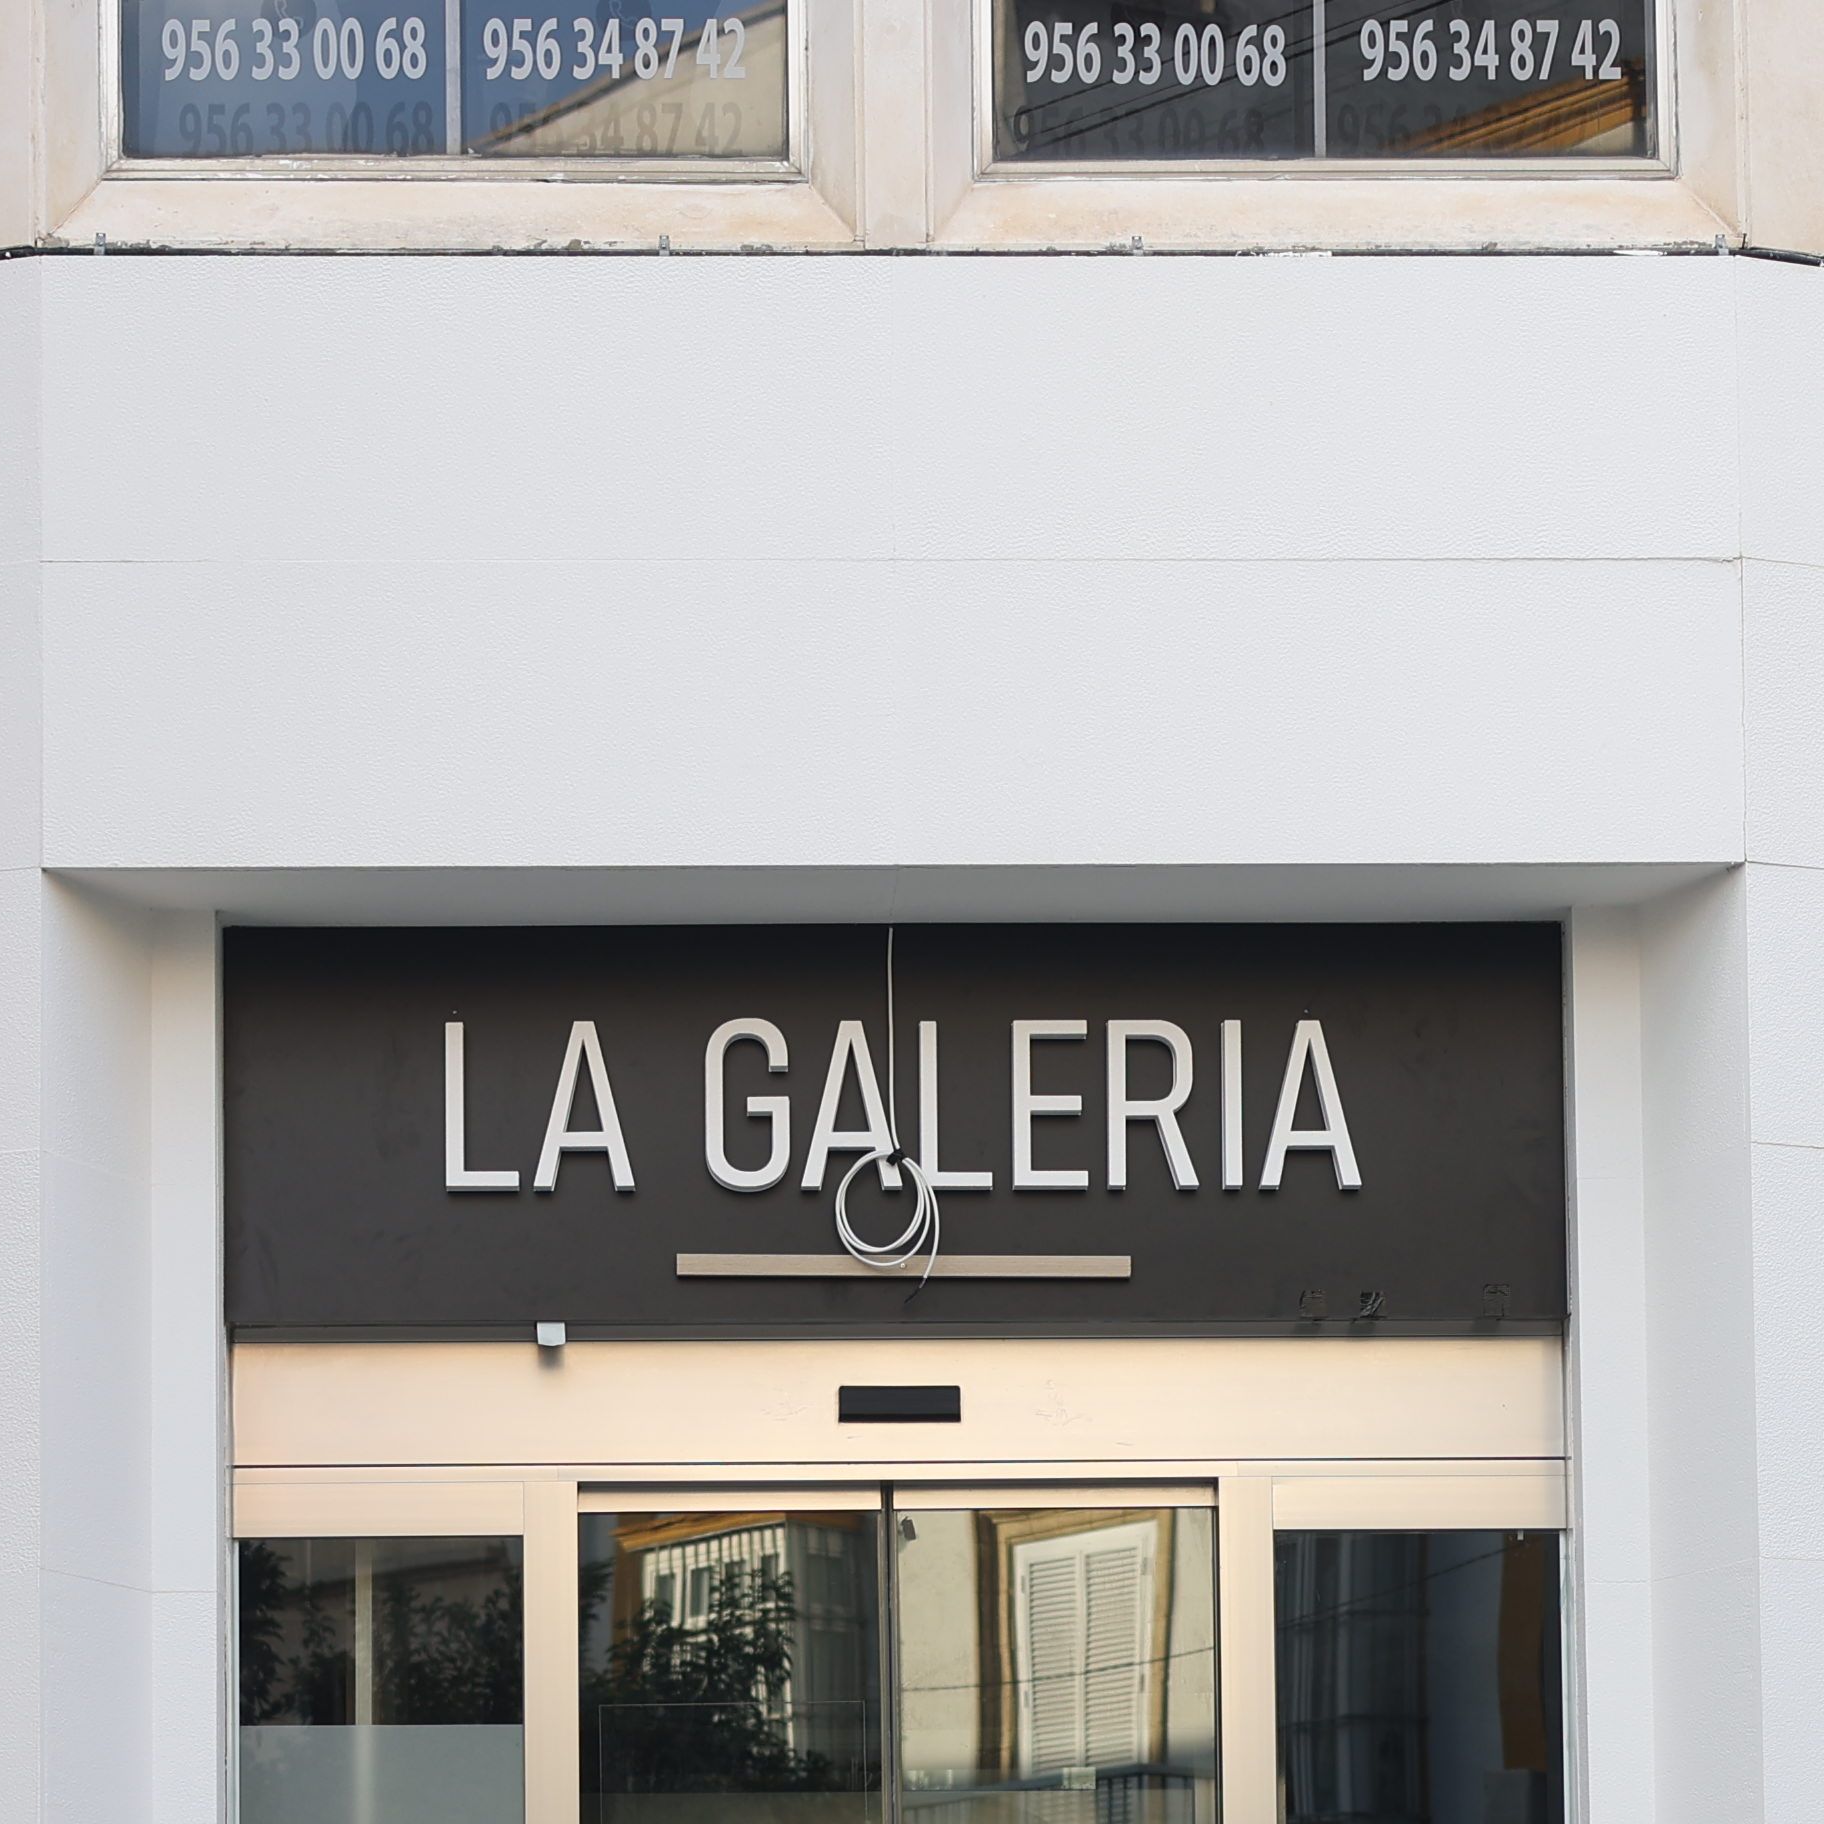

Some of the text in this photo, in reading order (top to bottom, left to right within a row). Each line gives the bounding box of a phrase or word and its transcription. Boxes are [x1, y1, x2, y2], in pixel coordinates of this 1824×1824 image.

[162, 18, 428, 82] 956 33 00 68
[484, 18, 747, 80] 956 34 87 42
[1025, 20, 1287, 87] 956 33 00 68
[1361, 18, 1622, 80] 956 34 87 42
[444, 1018, 1363, 1193] LA GALERIA
